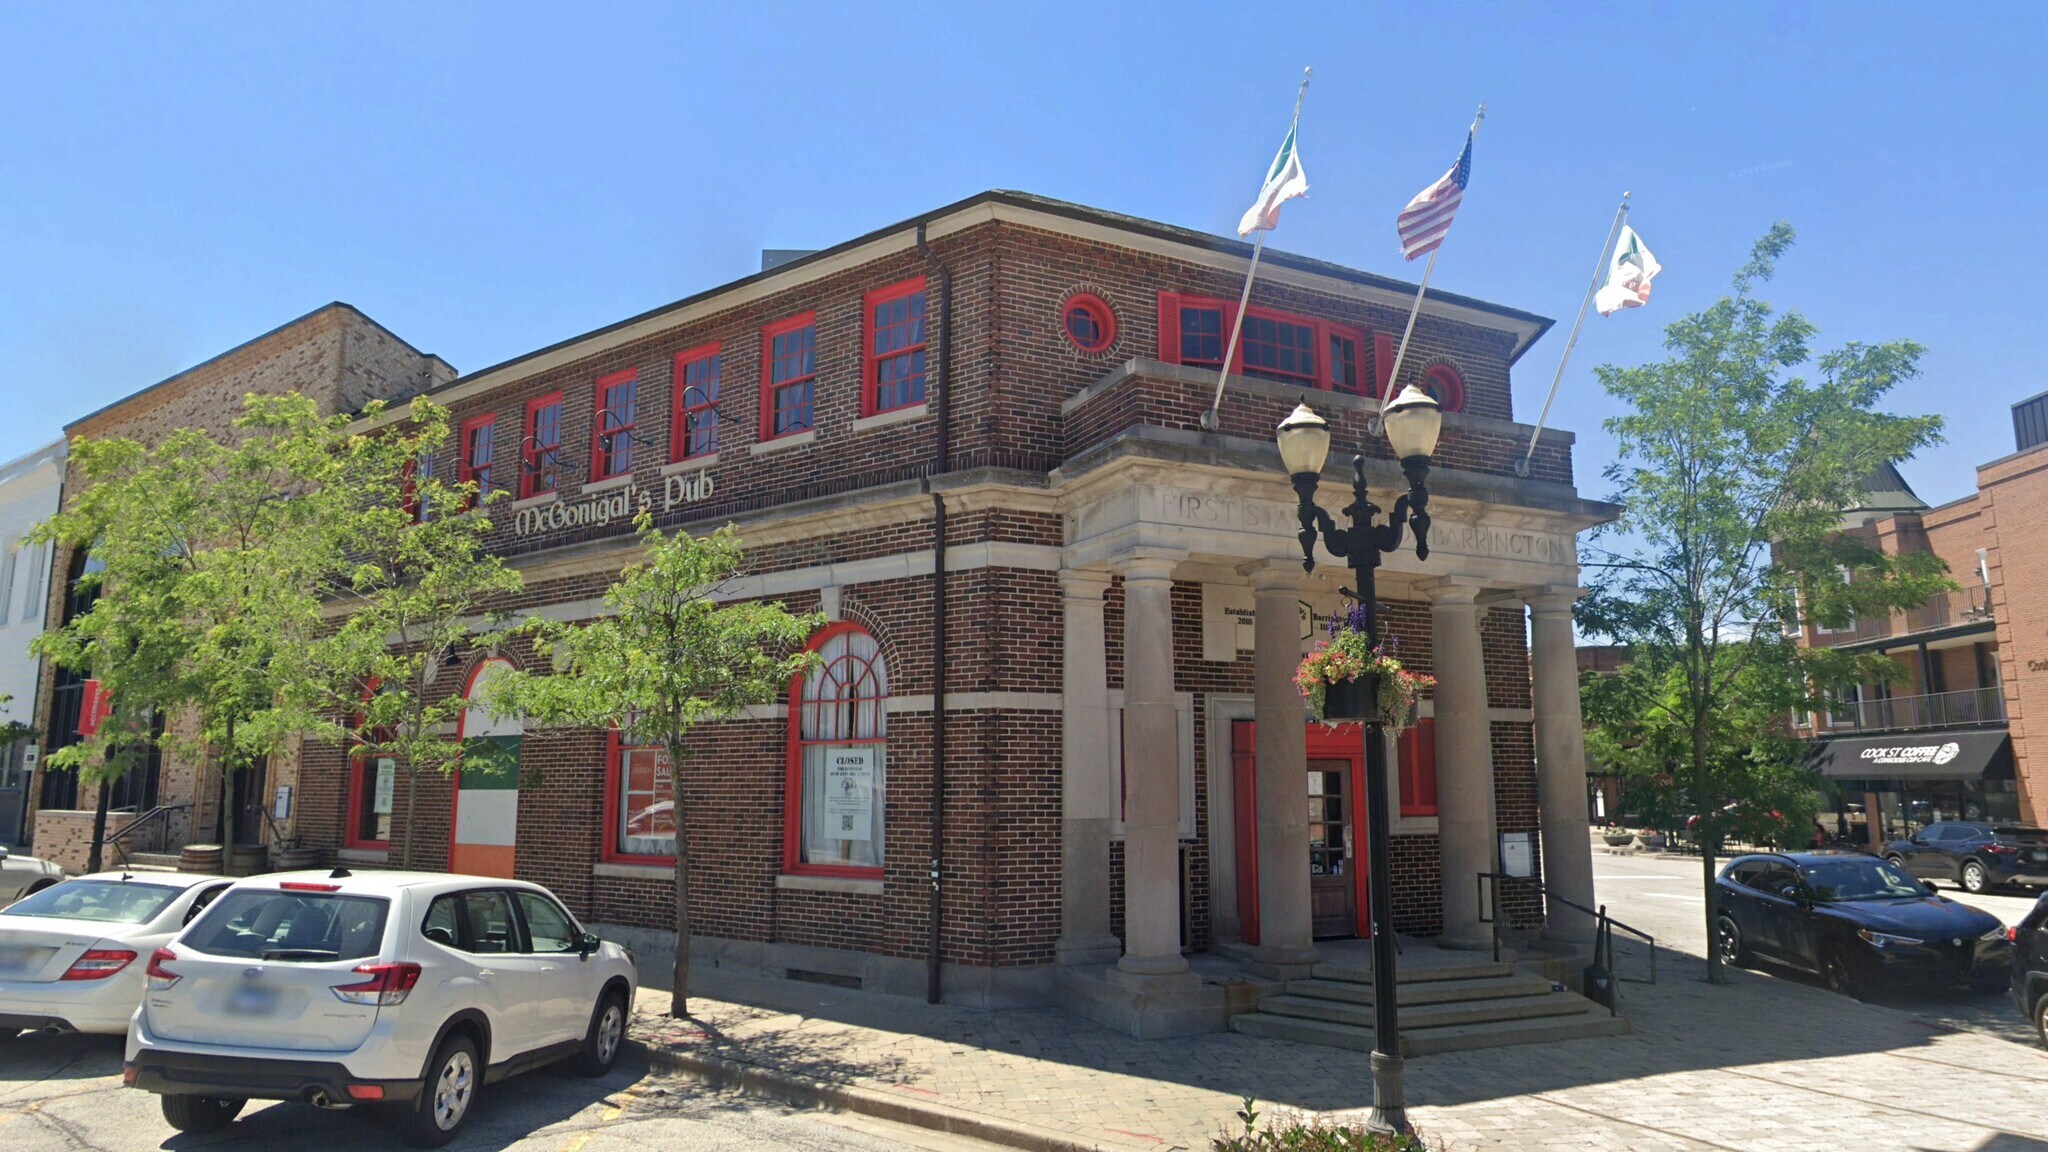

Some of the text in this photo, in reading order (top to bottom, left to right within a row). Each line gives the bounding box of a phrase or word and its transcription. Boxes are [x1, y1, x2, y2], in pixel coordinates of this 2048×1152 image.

[515, 468, 715, 536] McGonigal's Pub
[1162, 494, 1237, 524] FIRST
[1237, 617, 1253, 625] 2010
[1861, 746, 1940, 758] COOK ST COFFEE
[657, 755, 668, 764] FO
[836, 756, 864, 765] CLOSED
[656, 767, 671, 776] SAL
